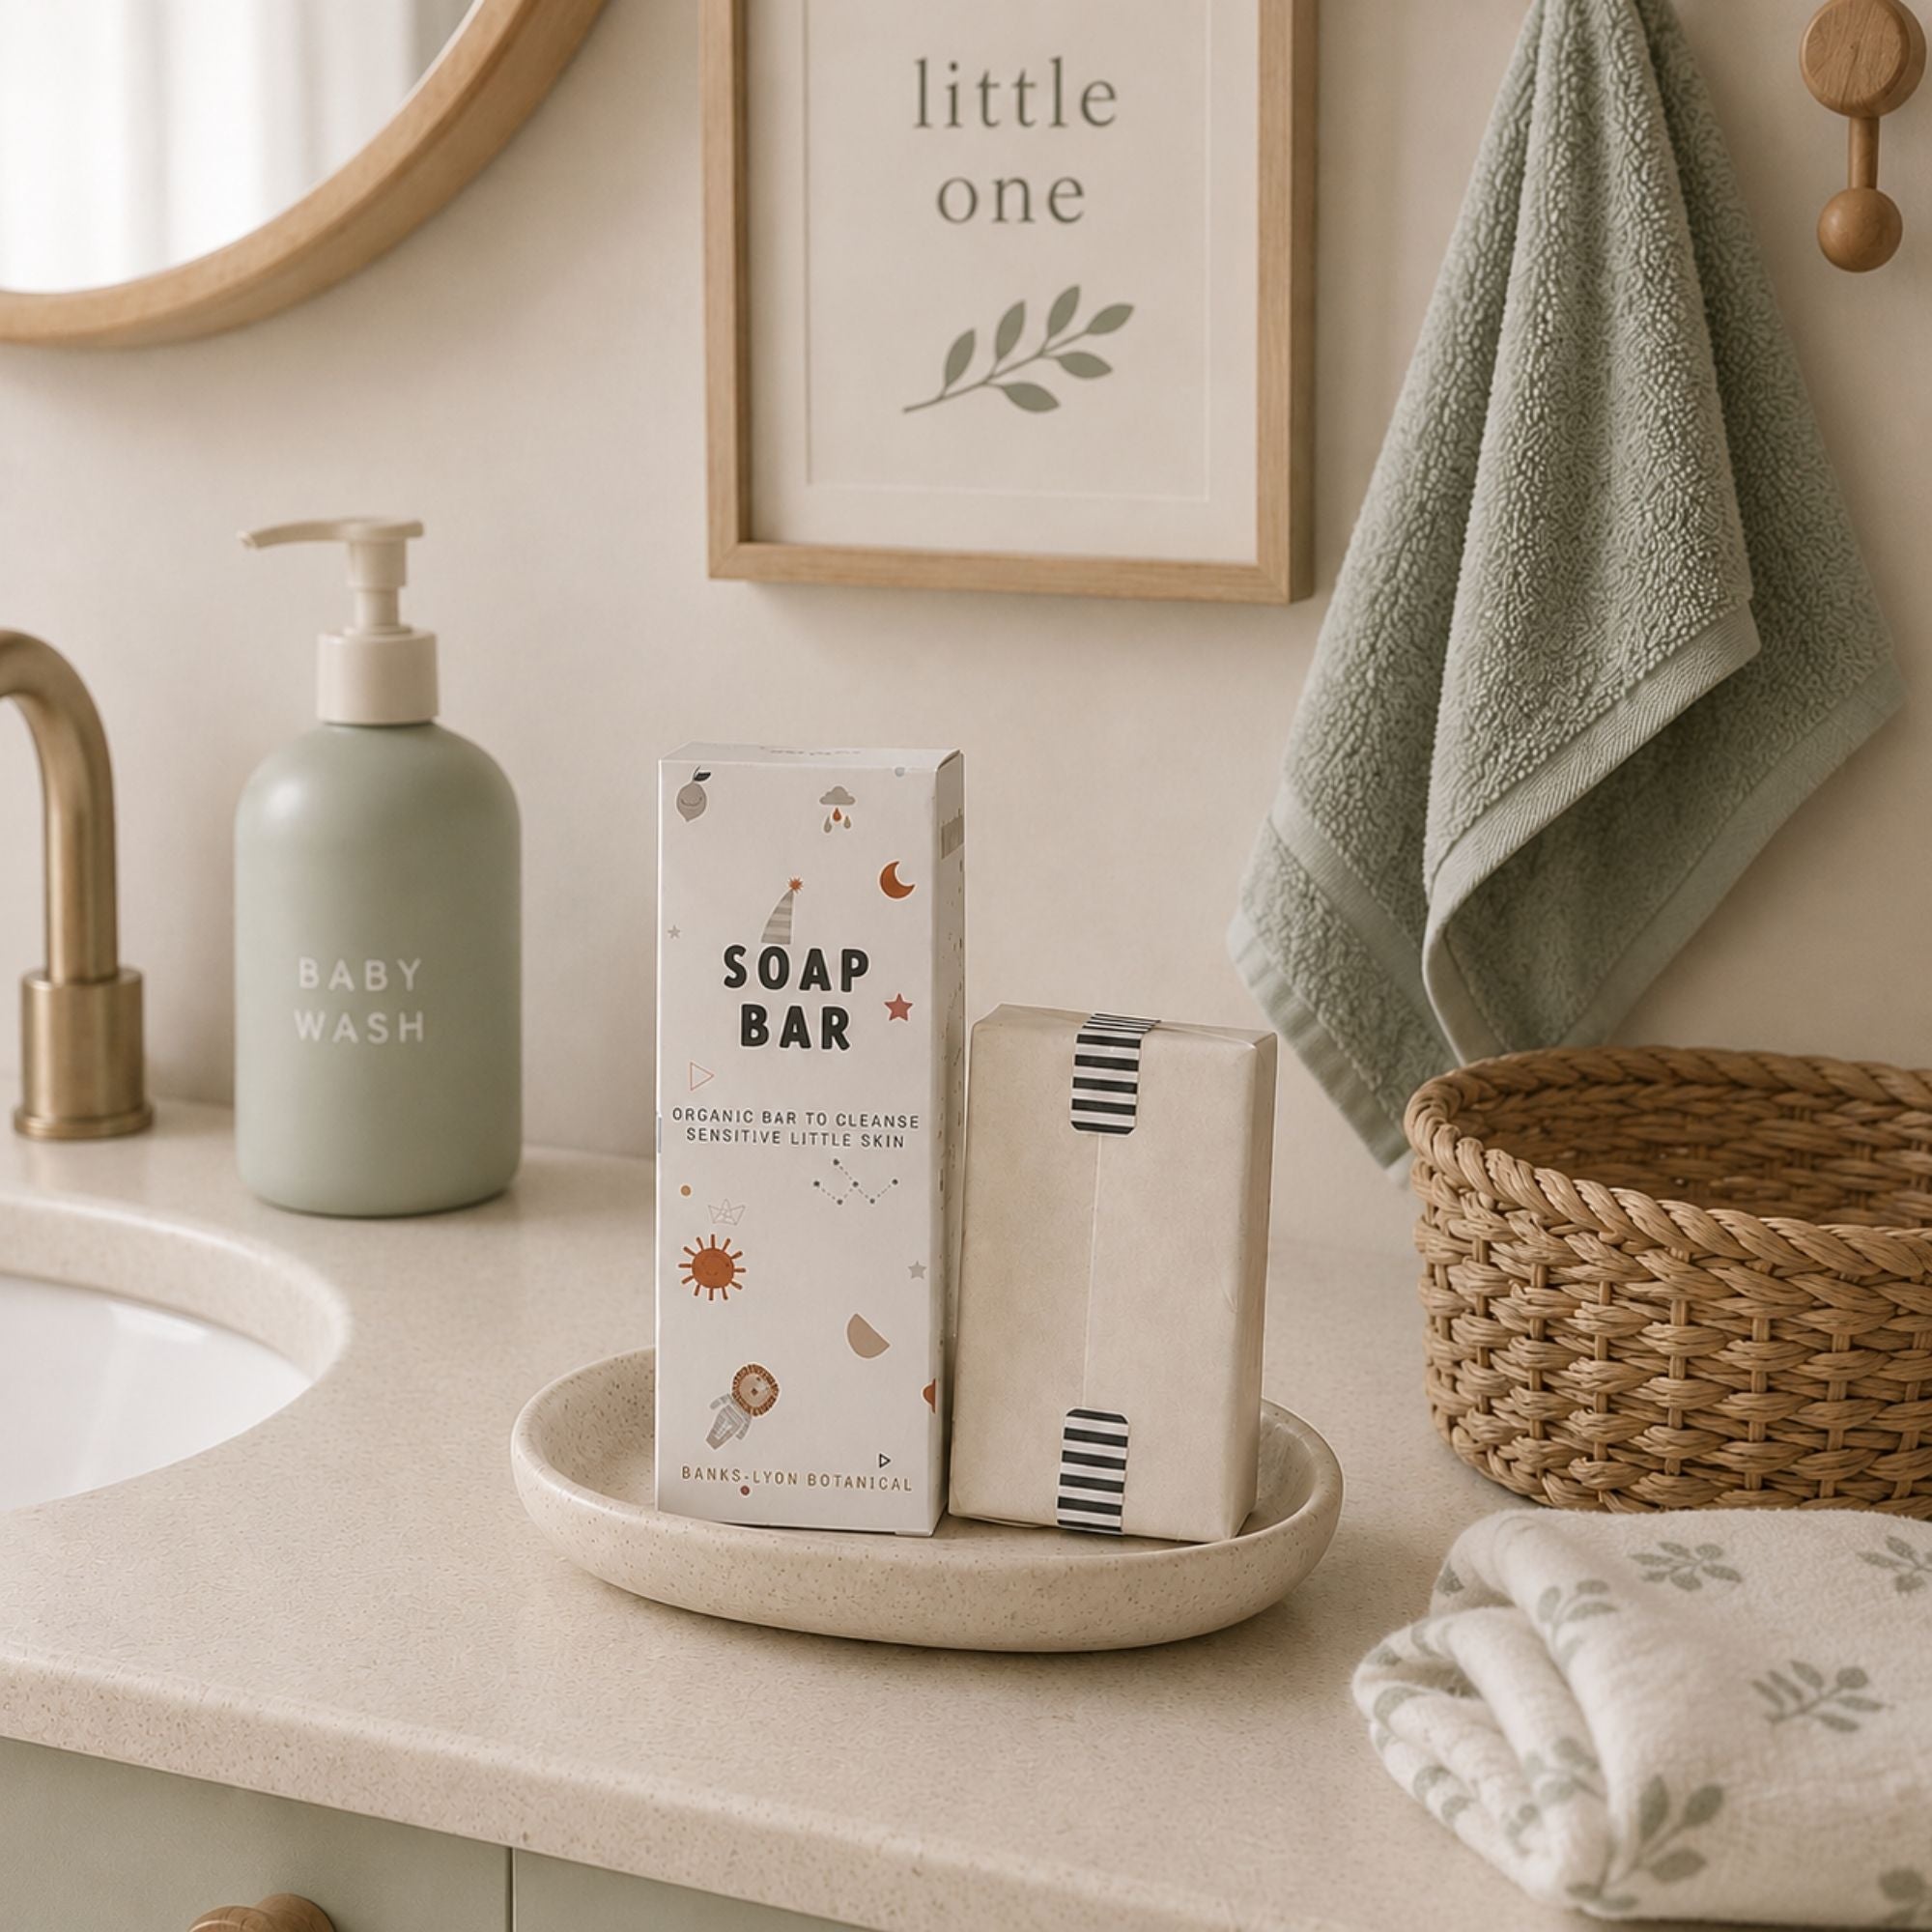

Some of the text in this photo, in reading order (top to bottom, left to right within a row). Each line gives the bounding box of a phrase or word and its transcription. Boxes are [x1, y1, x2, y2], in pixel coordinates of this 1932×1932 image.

[914, 56, 1118, 128] little
[936, 177, 1085, 224] one
[298, 955, 422, 992] BABY
[724, 945, 869, 993] SOAP
[293, 1009, 424, 1045] WASH
[740, 1004, 850, 1051] BAR
[672, 1107, 920, 1129] ORGANIC BAR TO CLEANSE
[686, 1127, 905, 1149] SENSITIVE LITTLE SKIN
[682, 1465, 913, 1492] BANKS-LYON BOTANICAL
